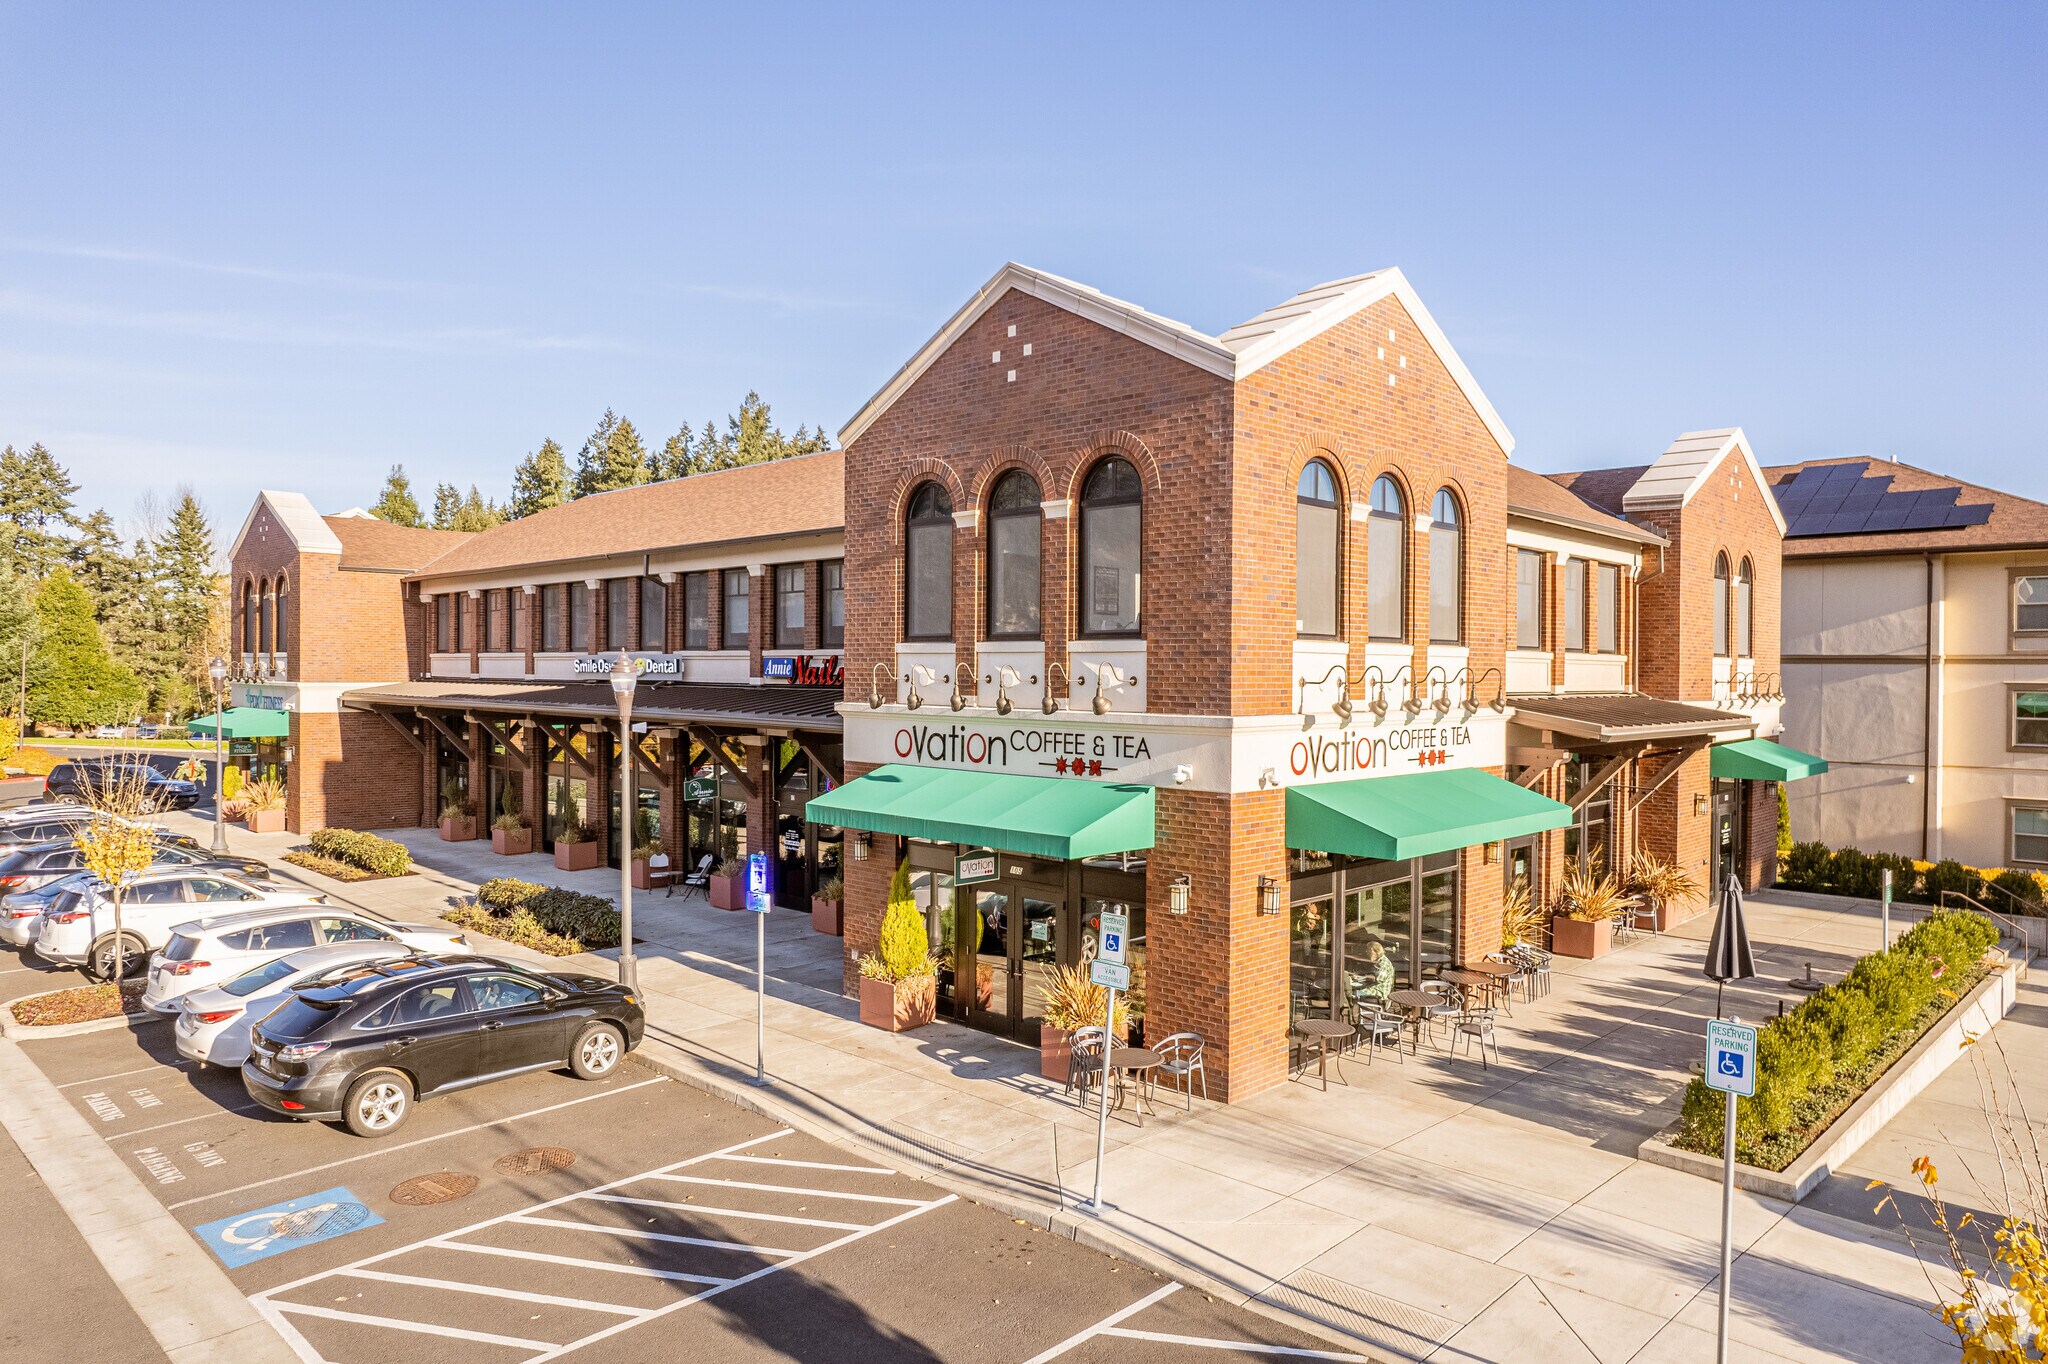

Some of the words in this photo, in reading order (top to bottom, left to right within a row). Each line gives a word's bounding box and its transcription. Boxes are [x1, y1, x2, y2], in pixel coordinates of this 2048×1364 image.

[646, 658, 677, 673] Dental
[764, 659, 792, 675] Annie
[1010, 729, 1085, 755] COFFEE
[1093, 735, 1105, 757] &
[1113, 735, 1152, 760] TEA
[1389, 728, 1437, 750] COFFEE
[1440, 728, 1448, 746] &
[1451, 726, 1471, 746] TEA
[1103, 915, 1125, 927] RESERVED
[1104, 924, 1123, 934] PARKING
[1097, 974, 1122, 985] ACCESSIBLE
[1105, 967, 1117, 976] VAN
[1711, 1025, 1753, 1042] RESERVED
[1714, 1037, 1749, 1053] PARKING
[82, 1091, 126, 1122] PARKING
[133, 1094, 164, 1109] MIN
[133, 1146, 187, 1185] PARKING
[192, 1149, 228, 1168] MIN
